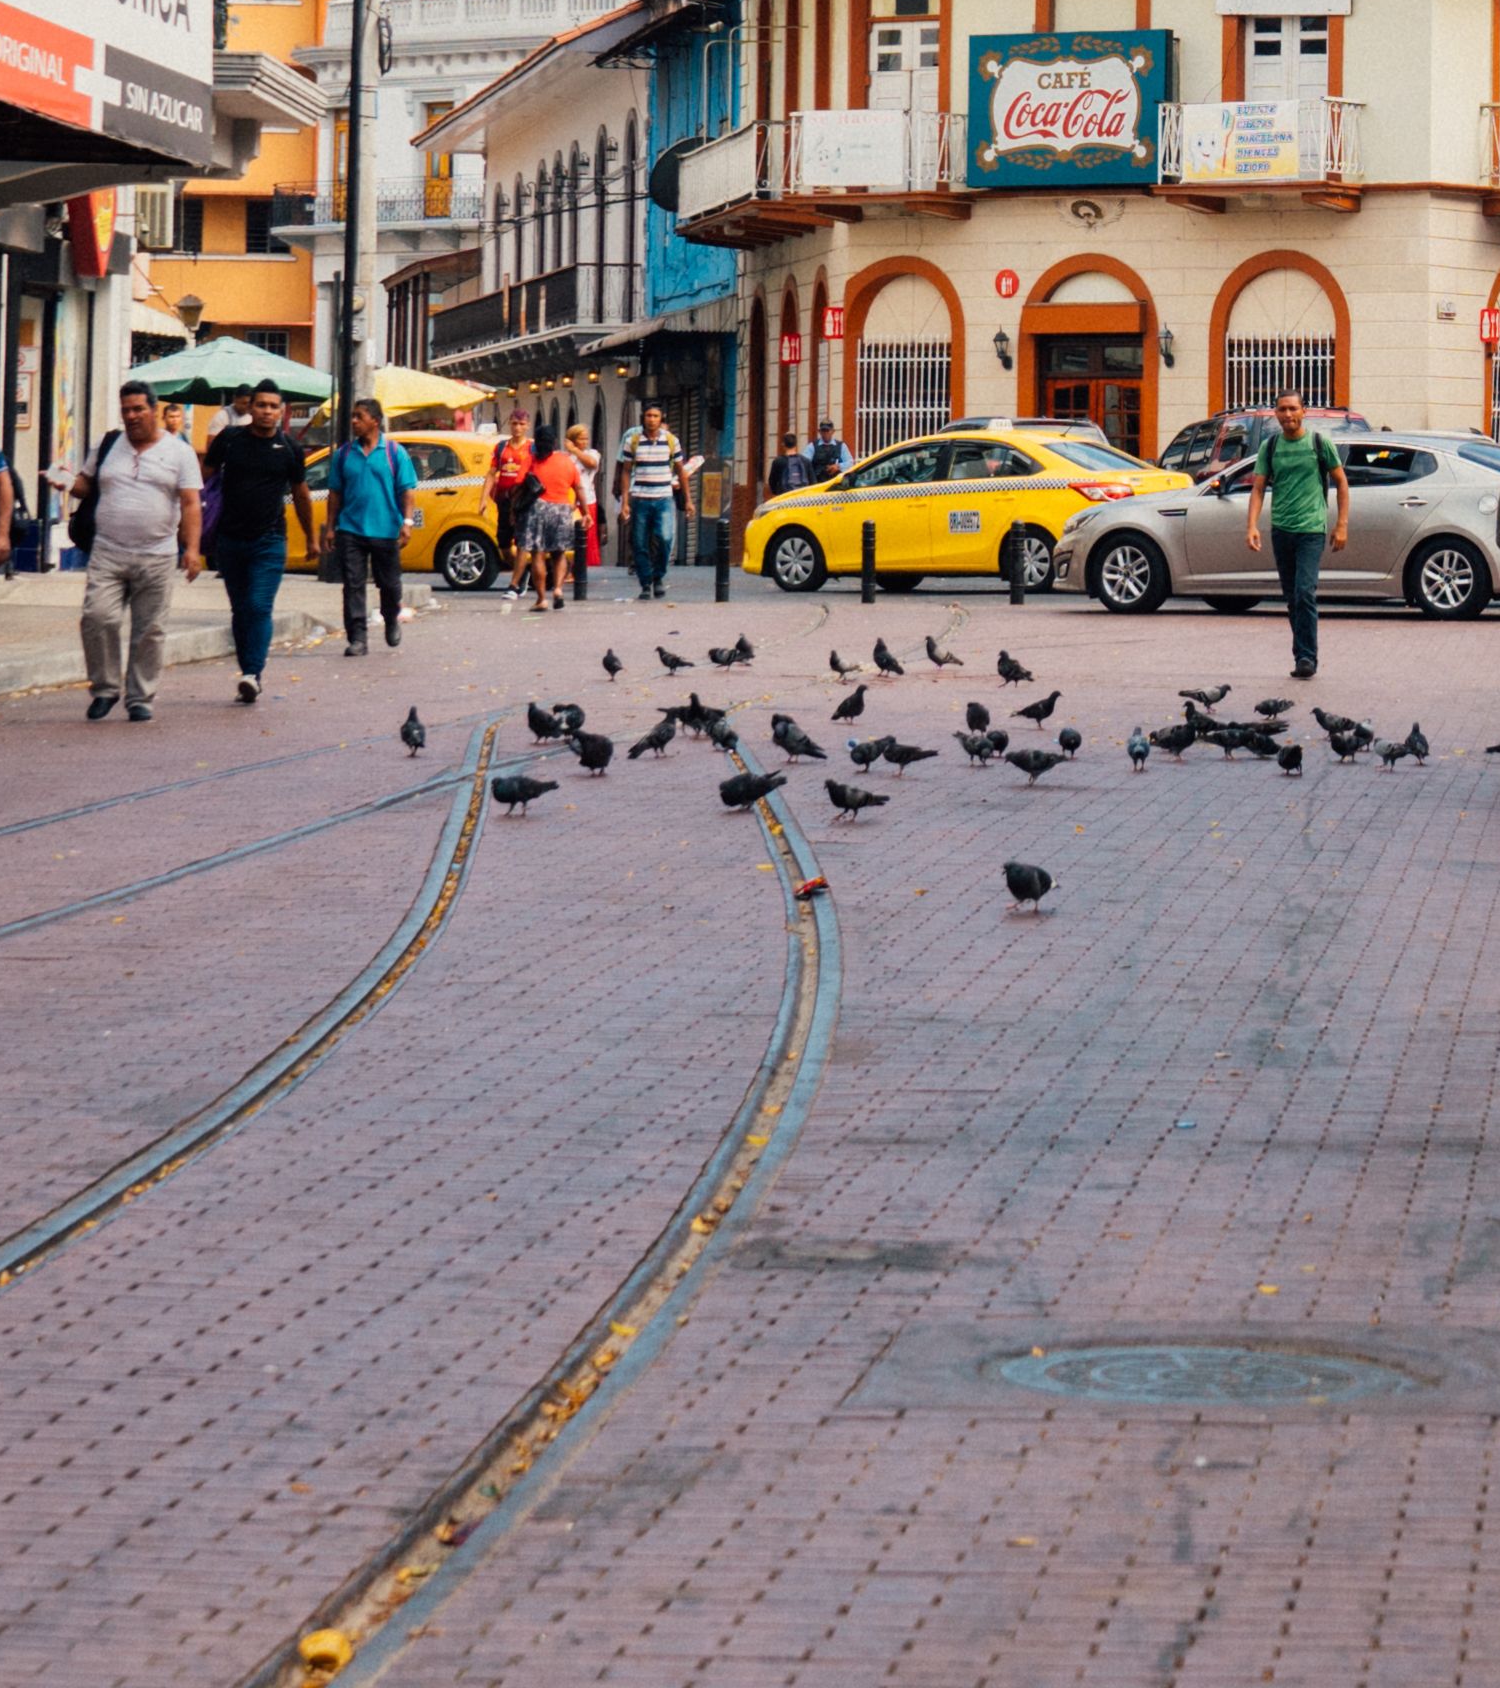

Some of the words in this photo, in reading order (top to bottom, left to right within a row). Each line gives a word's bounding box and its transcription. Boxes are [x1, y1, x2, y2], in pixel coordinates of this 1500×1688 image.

[1037, 67, 1091, 90] CAFÉ
[126, 82, 148, 113] SIN
[149, 92, 203, 133] AZUCAR
[1003, 89, 1132, 140] Coca-Cola
